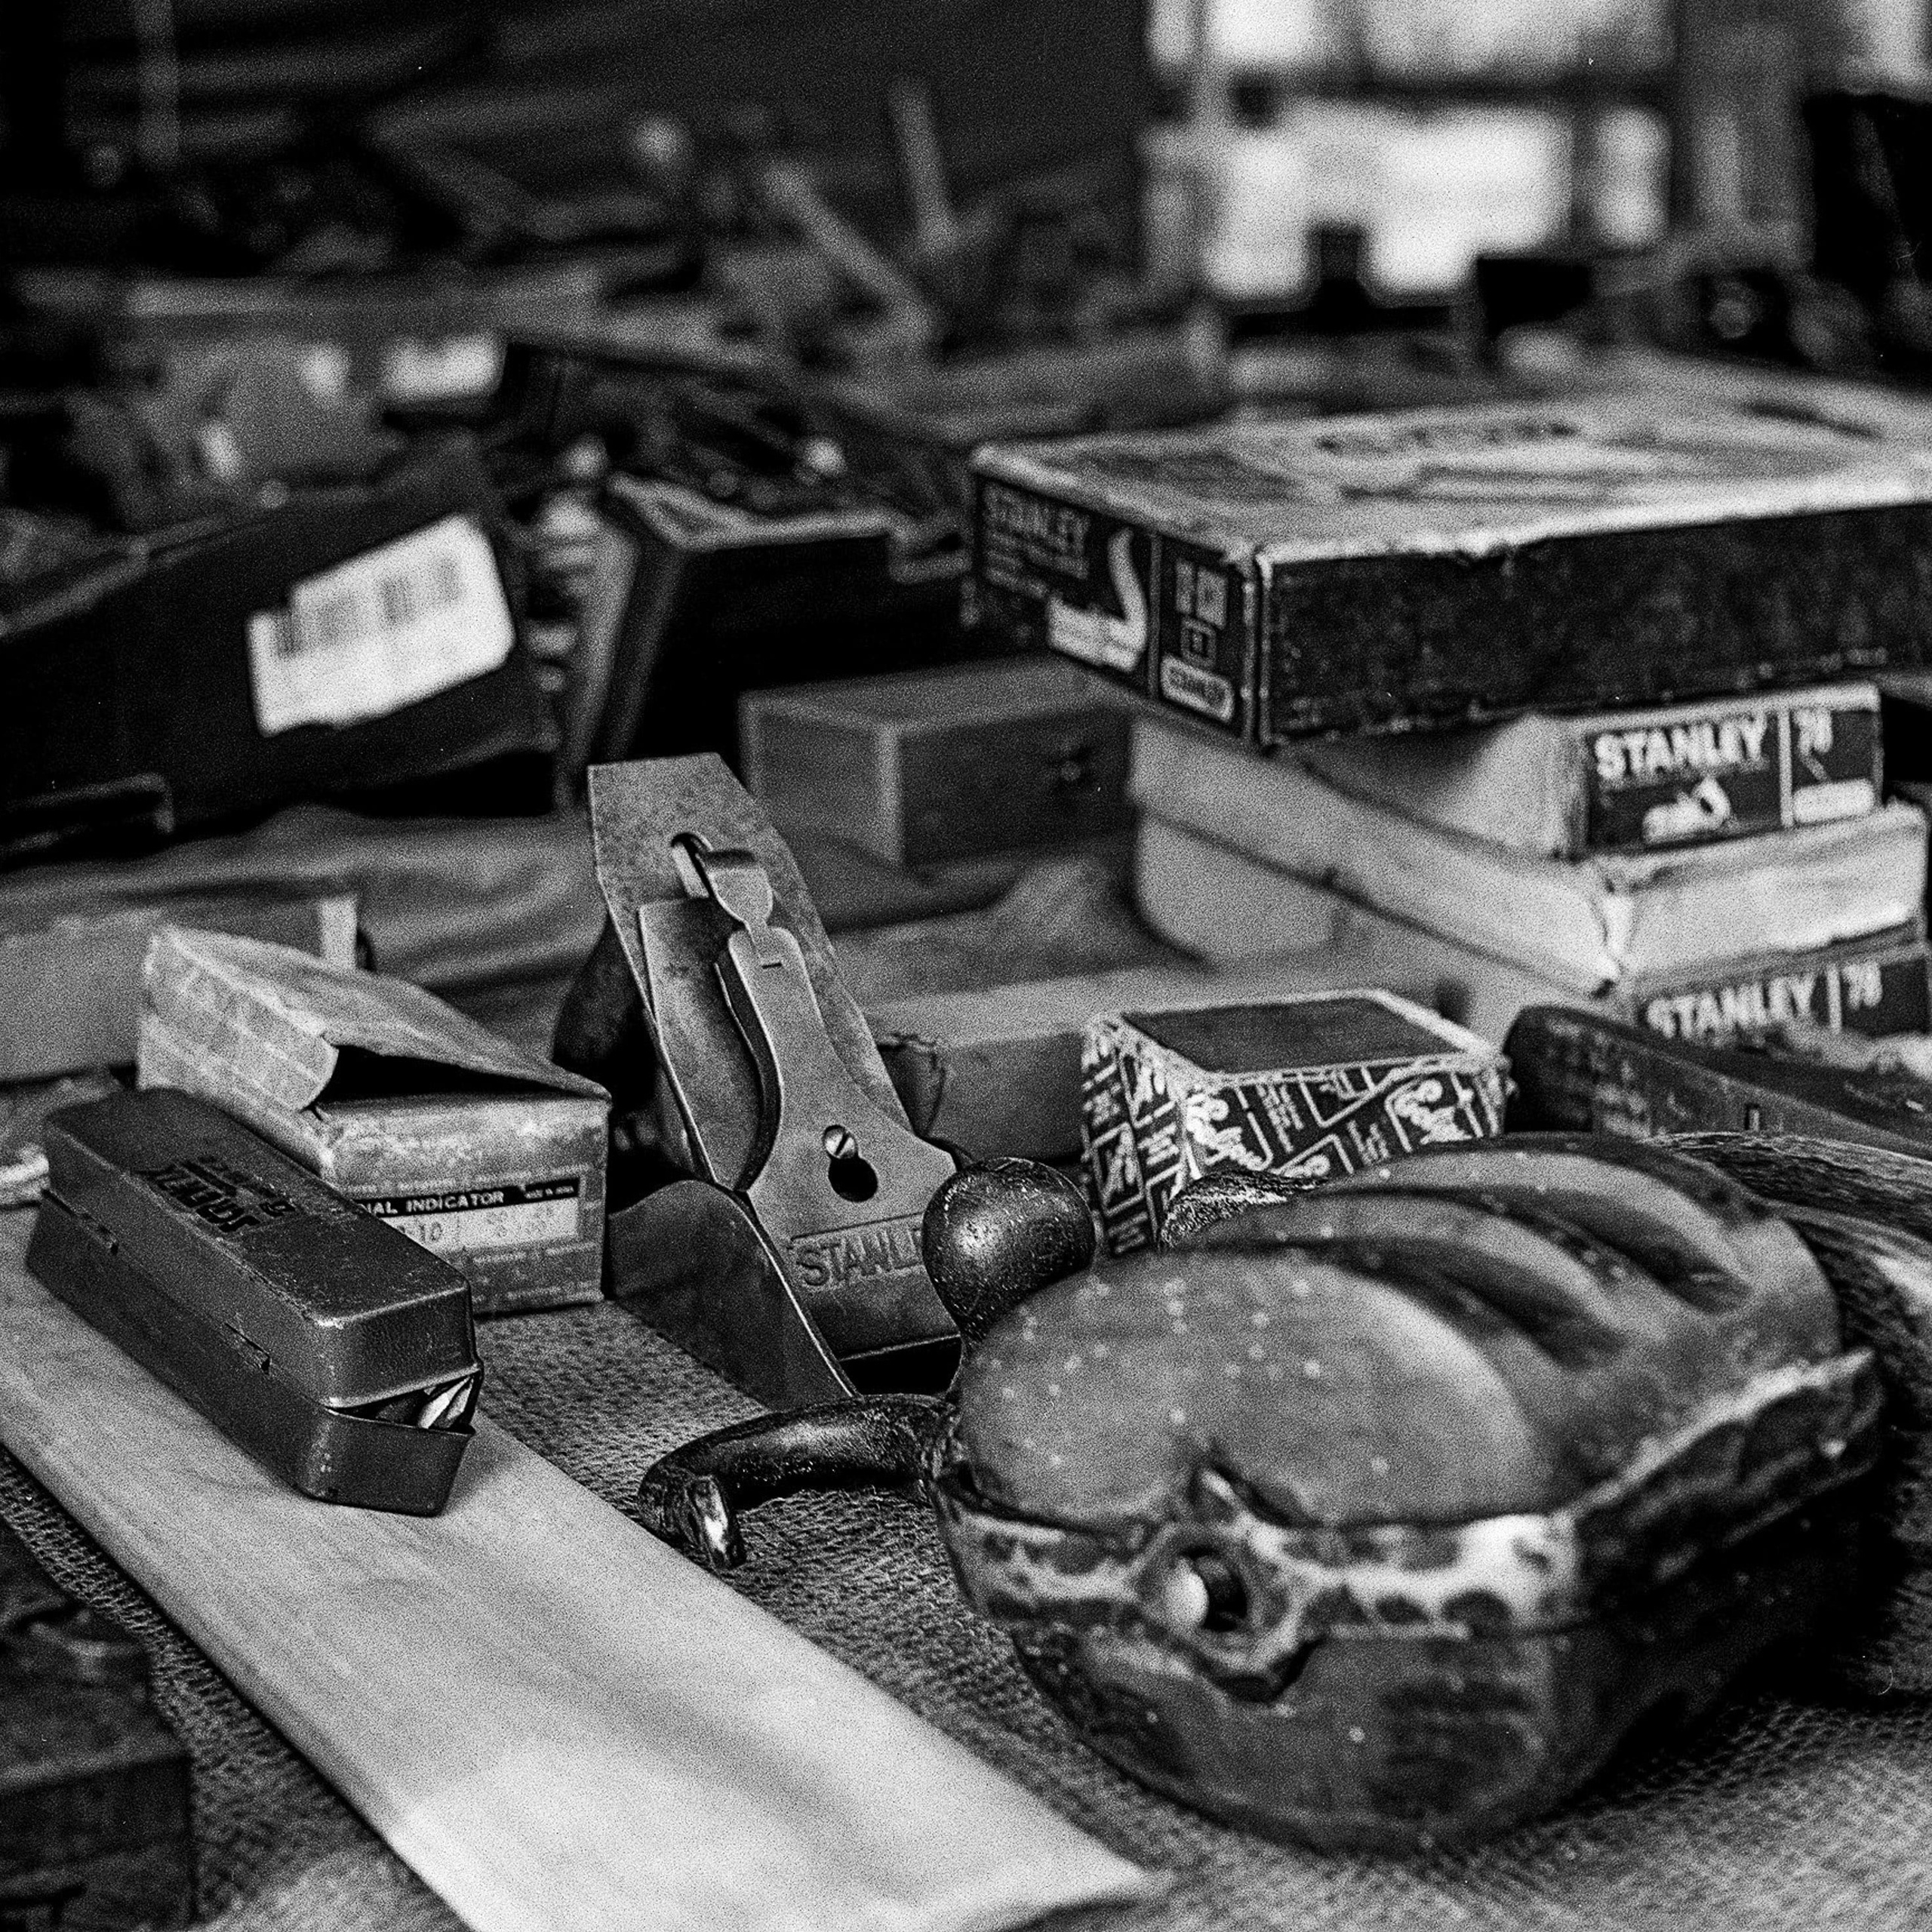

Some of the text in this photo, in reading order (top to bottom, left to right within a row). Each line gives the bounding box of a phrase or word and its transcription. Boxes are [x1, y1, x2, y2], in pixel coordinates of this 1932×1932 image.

[1595, 713, 1767, 781] STANLEY
[1646, 975, 1817, 1040] STANLEY
[405, 1190, 504, 1213] INDICATOR
